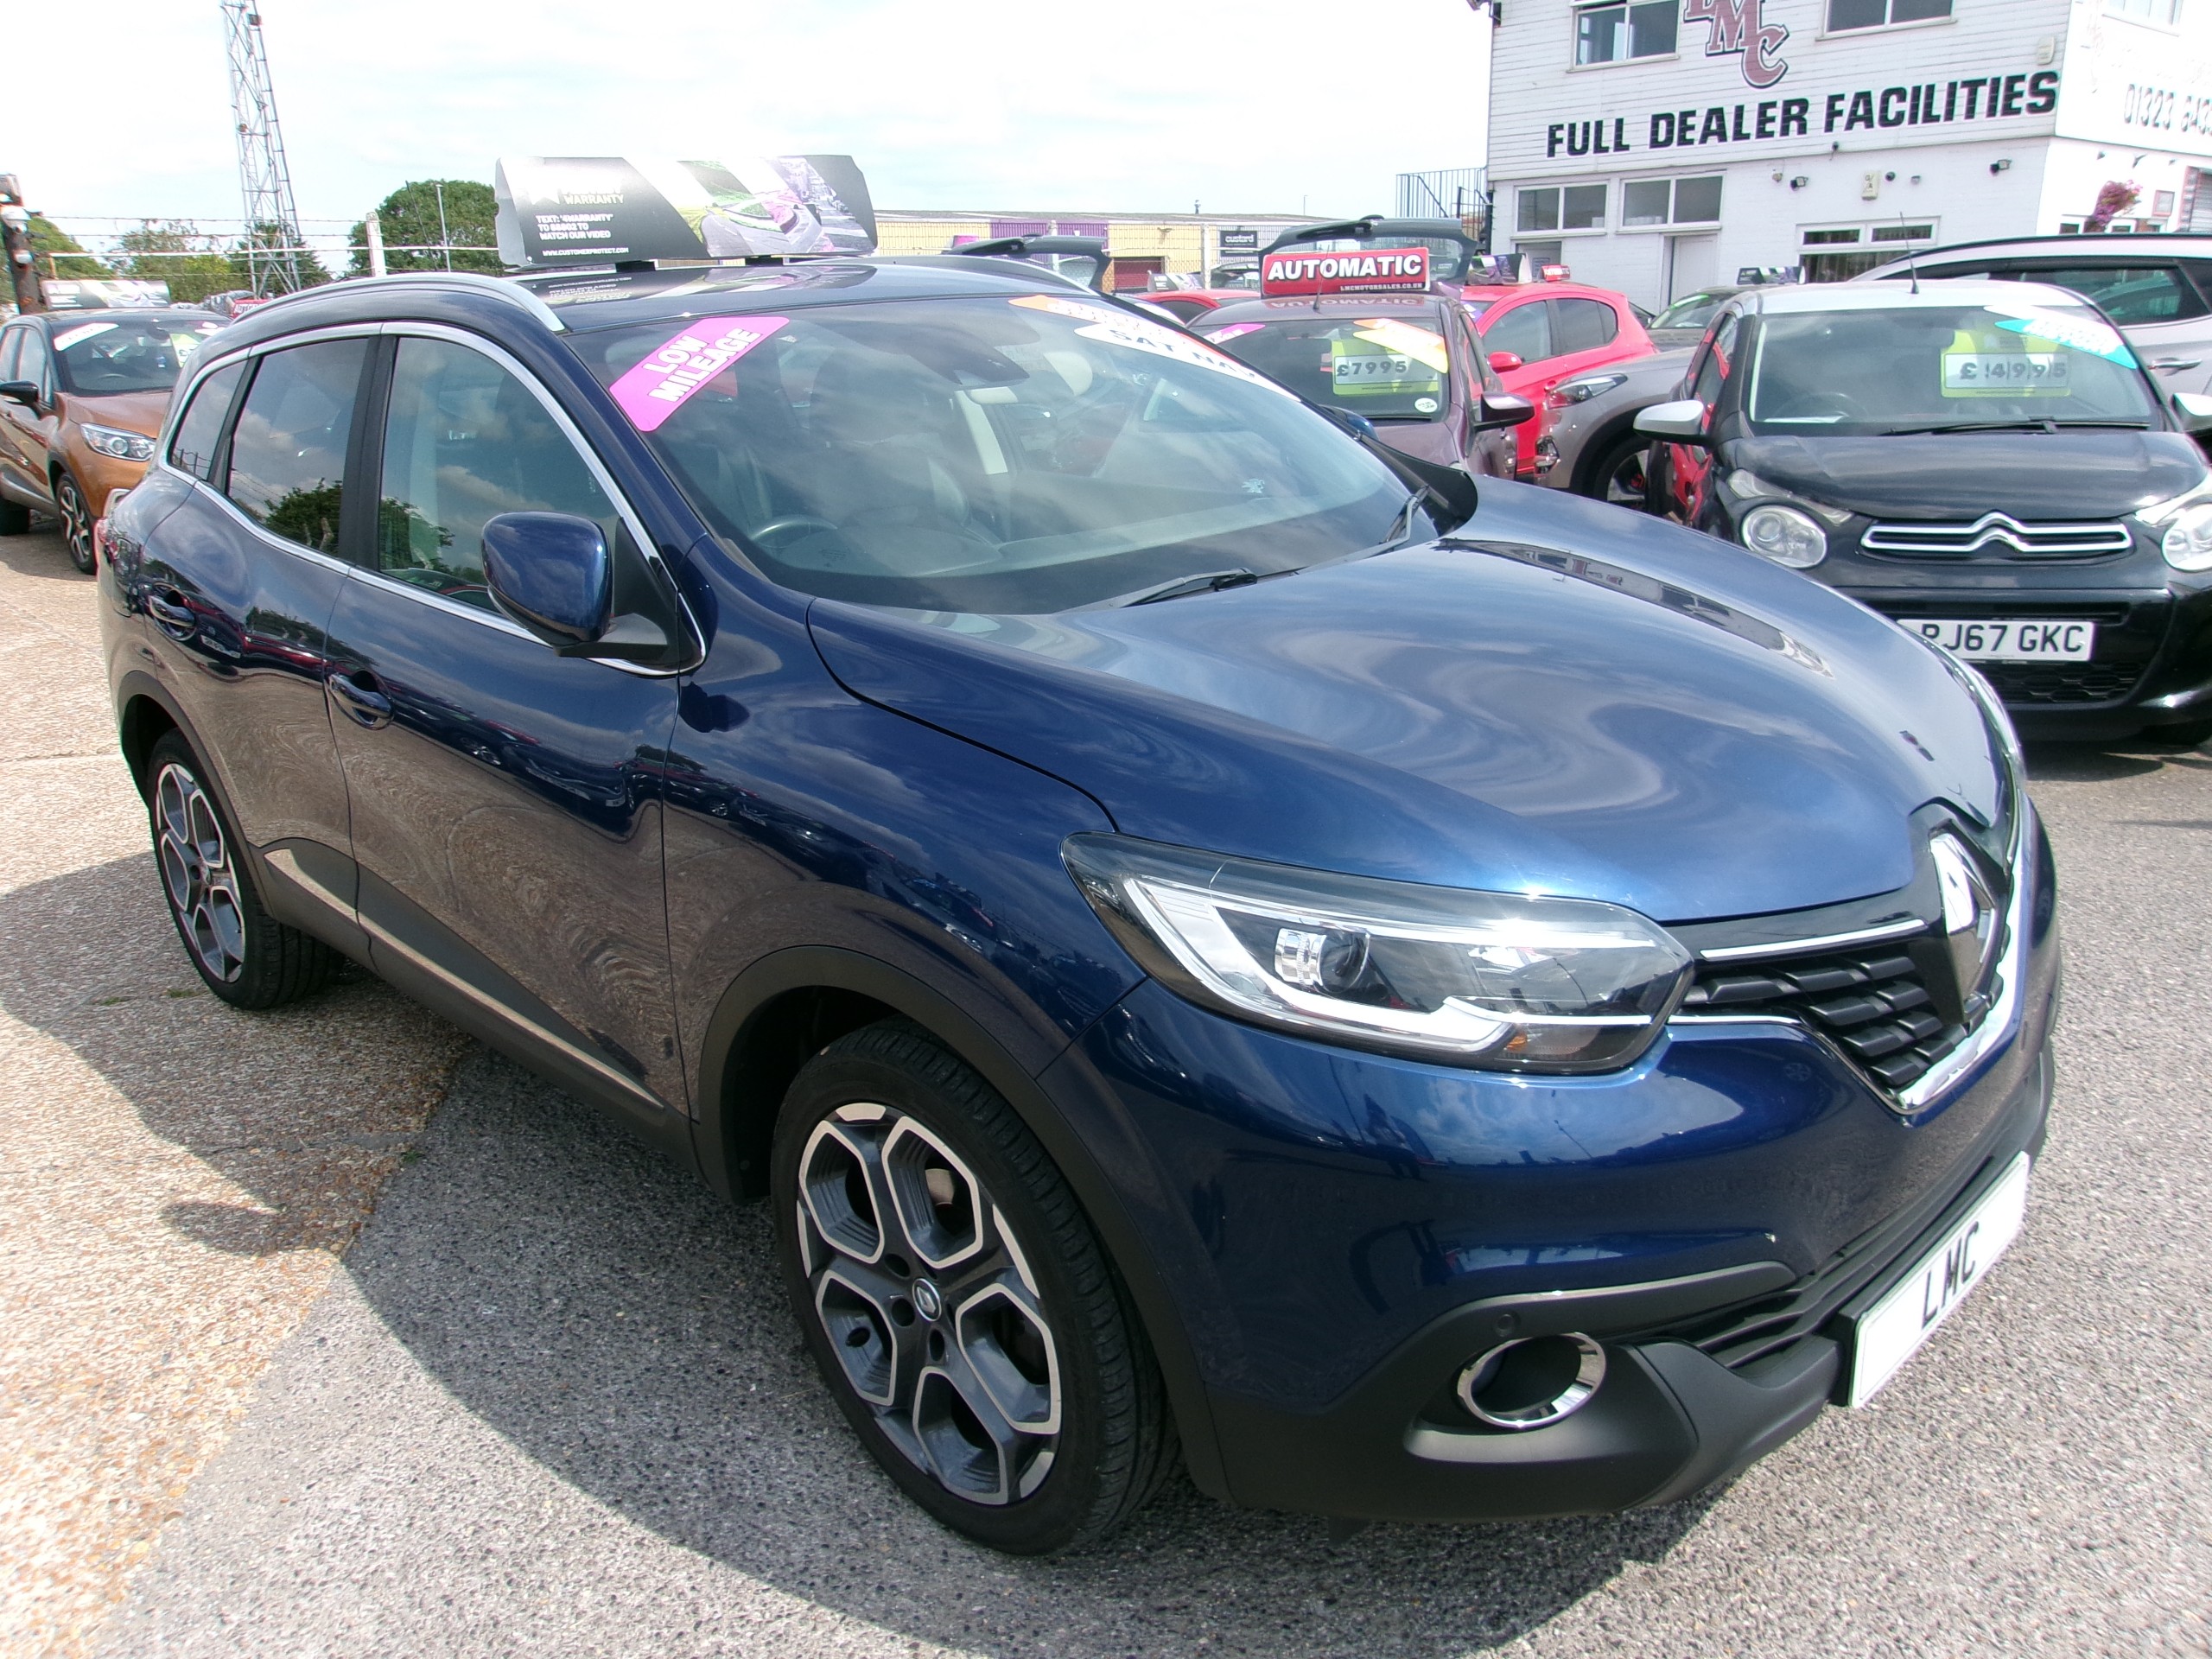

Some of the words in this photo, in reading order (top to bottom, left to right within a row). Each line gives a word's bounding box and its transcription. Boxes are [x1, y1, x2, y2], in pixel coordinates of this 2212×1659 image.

[1547, 117, 1630, 158] FULL
[1649, 97, 1810, 149] DEALER
[1823, 69, 2060, 133] FACILITIES
[2124, 83, 2175, 131] 01323
[2180, 95, 2212, 137] 843
[563, 194, 624, 205] WARRANTY
[536, 214, 560, 224] TEXT:
[537, 223, 550, 232] TO
[577, 222, 589, 231] TO
[539, 231, 569, 241] WATCH
[569, 231, 587, 239] OUR
[587, 230, 612, 239] VIDEO
[1224, 234, 1255, 243] custard
[1267, 254, 1422, 281] AUTOMATIC
[642, 335, 709, 374] LOW
[647, 327, 764, 403] MILEAGE
[1336, 360, 1407, 377] £7995
[2018, 624, 2084, 652] GKC
[1922, 1221, 1980, 1329] LMC
